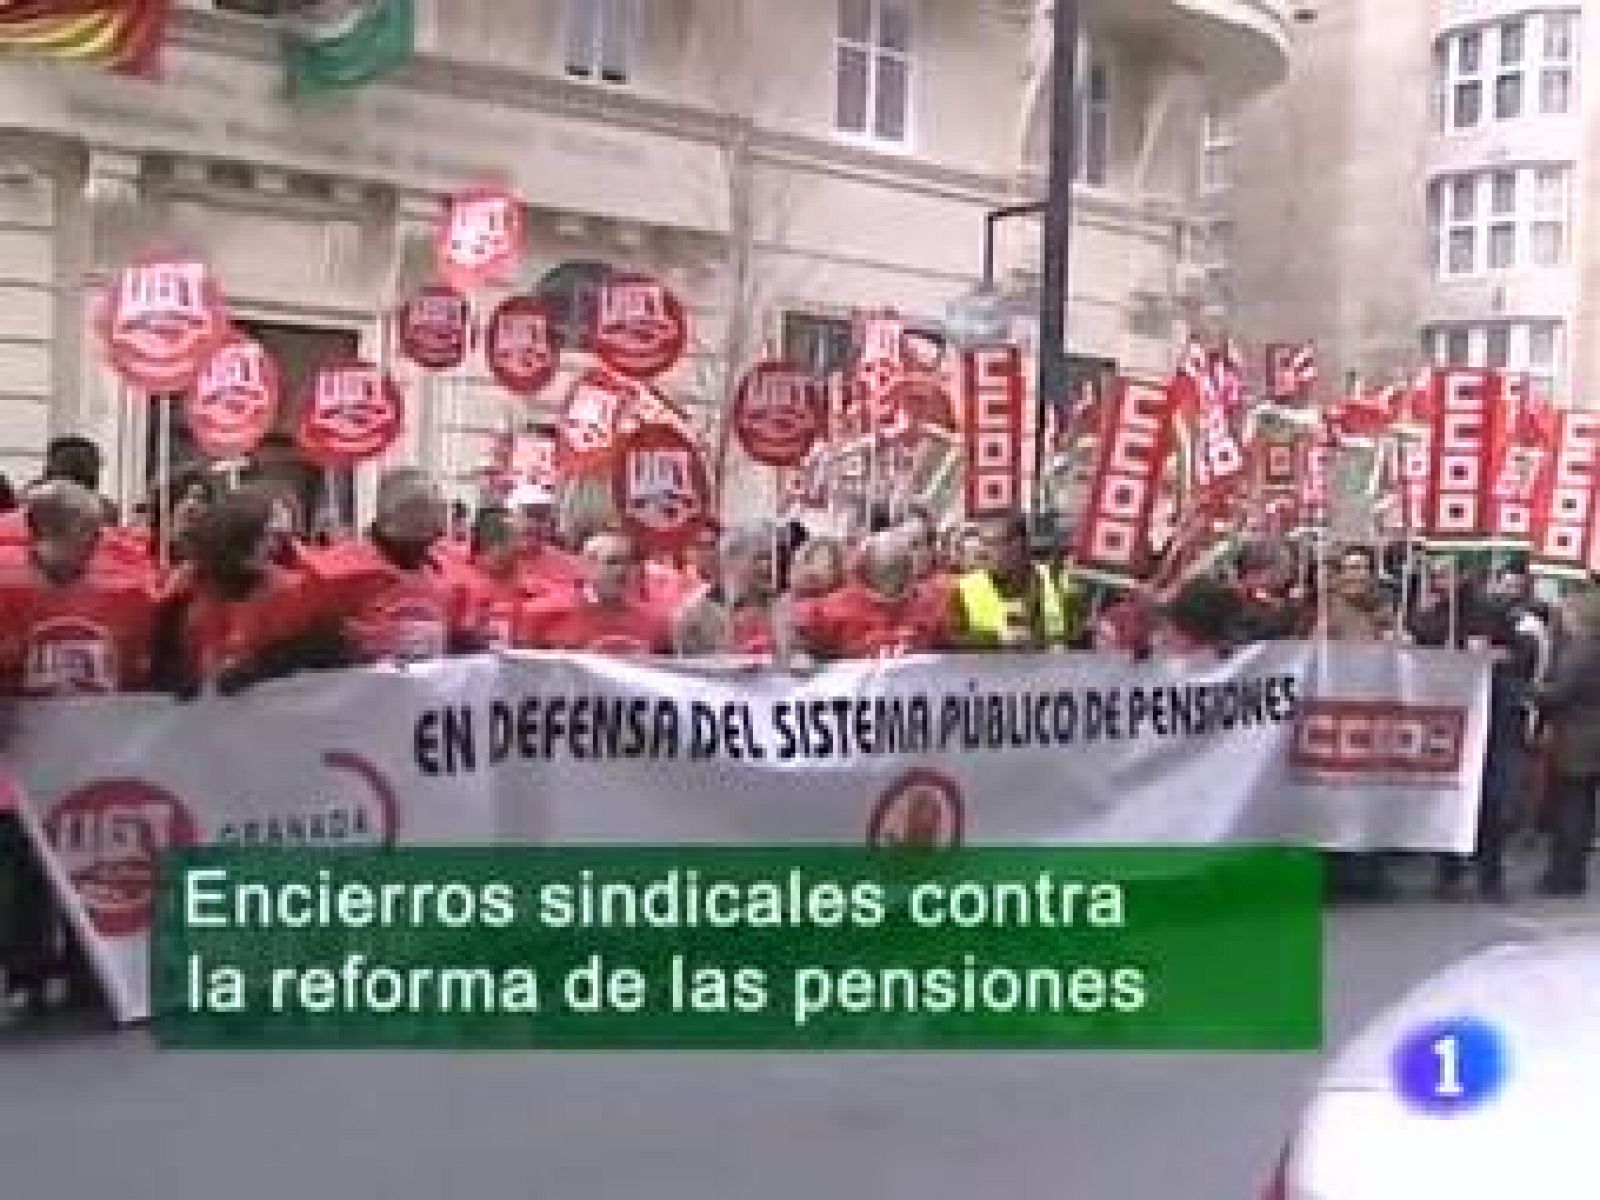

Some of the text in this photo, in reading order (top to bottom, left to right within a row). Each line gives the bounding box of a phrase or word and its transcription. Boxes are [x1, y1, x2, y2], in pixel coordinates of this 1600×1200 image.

[413, 676, 1295, 776] EN DEFENSA DEL SISTEMA PÚBLICO DE PENSIONES
